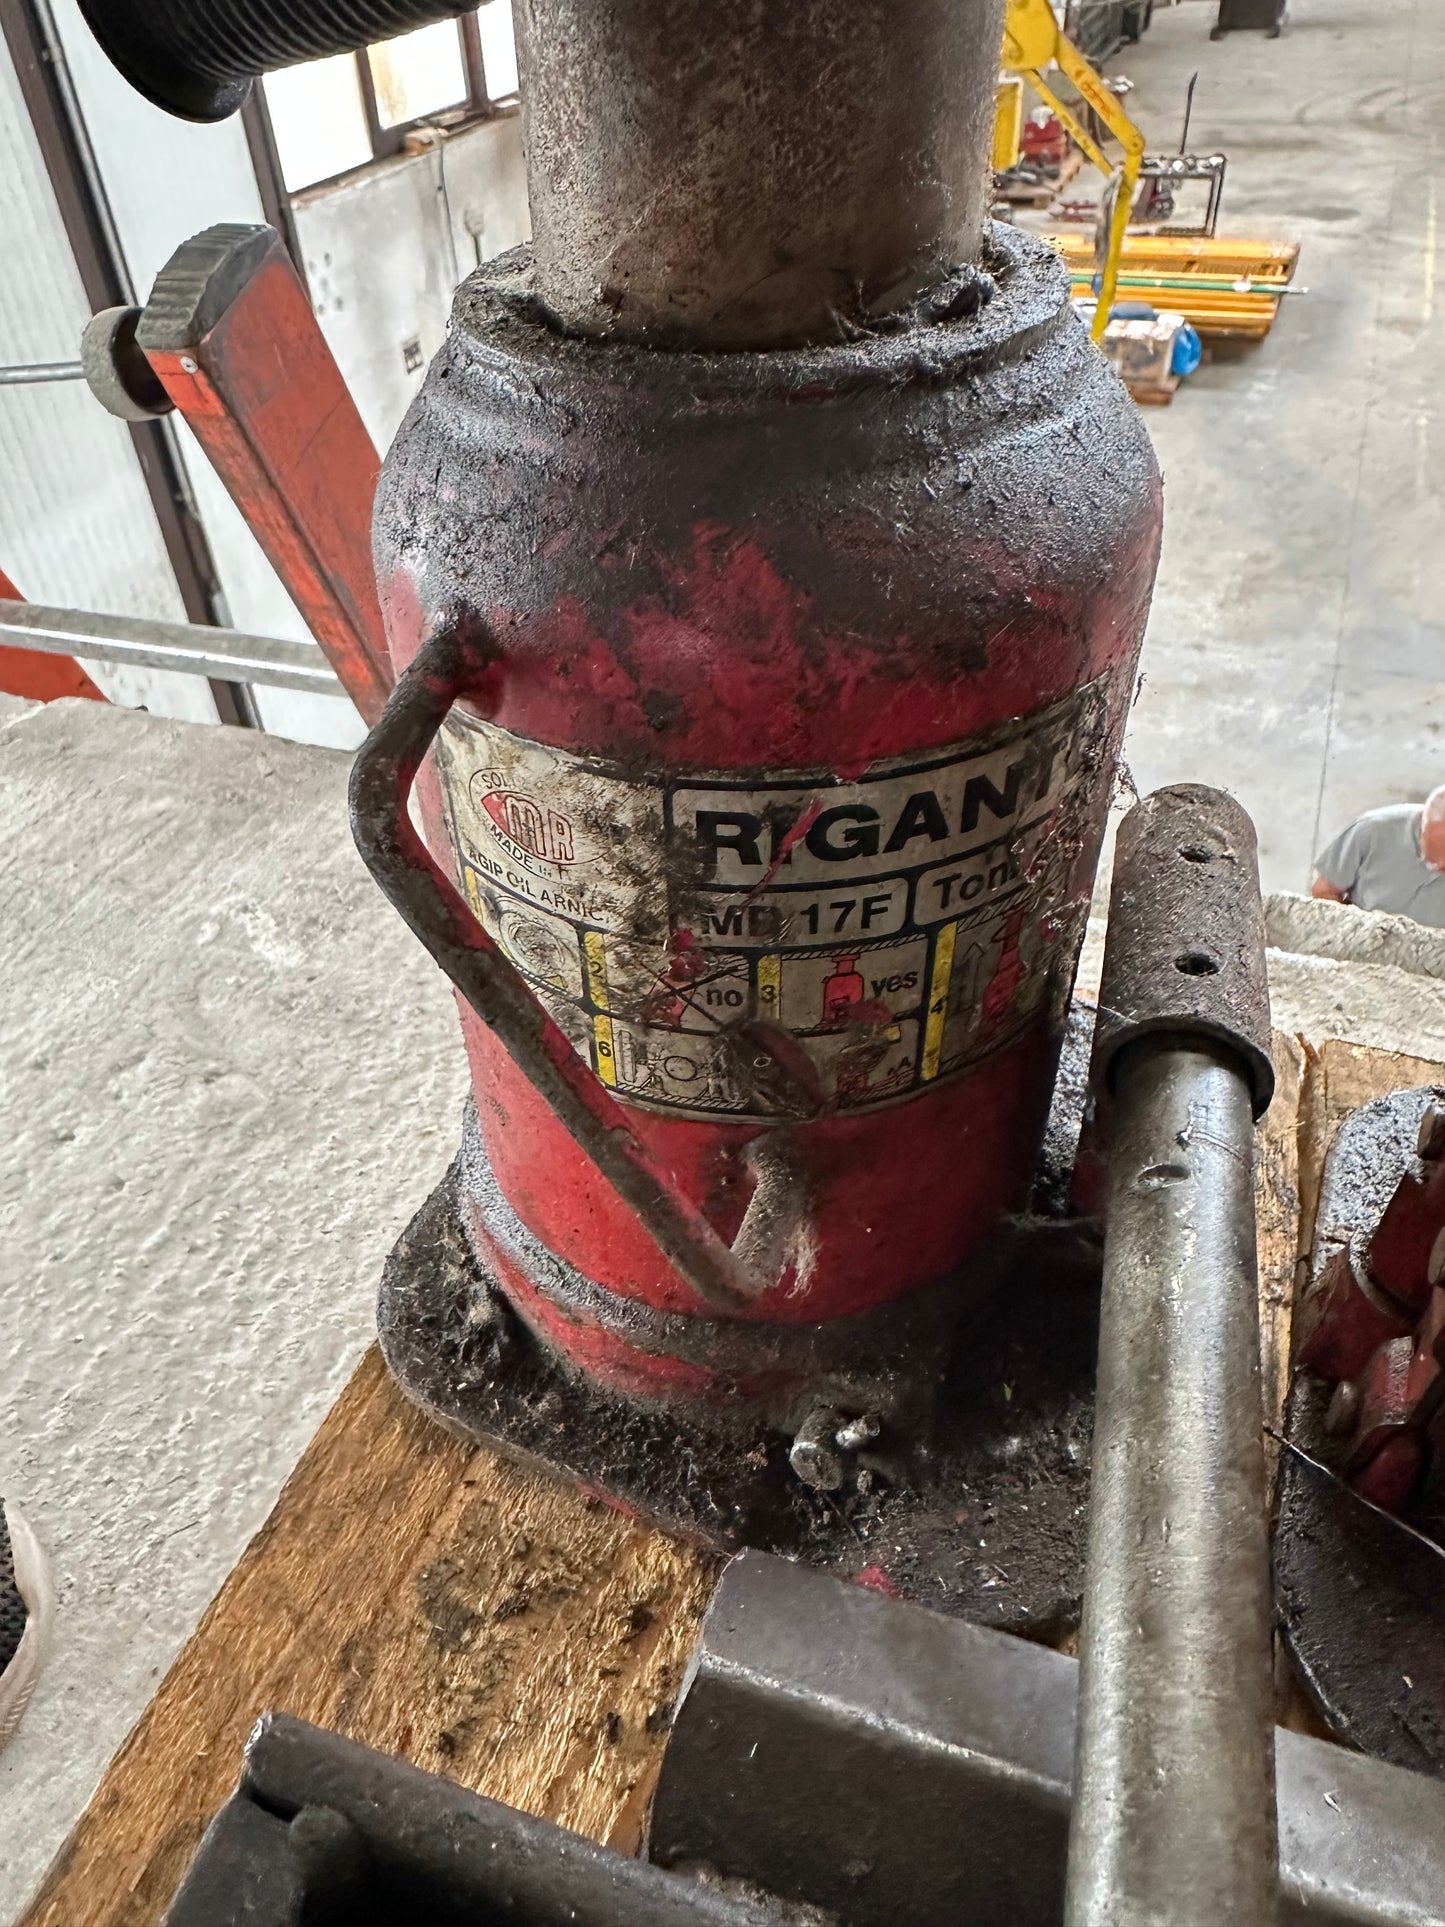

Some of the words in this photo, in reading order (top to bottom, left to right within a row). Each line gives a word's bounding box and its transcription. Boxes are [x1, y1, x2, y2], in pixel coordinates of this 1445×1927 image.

[490, 823, 534, 870] MADE
[468, 848, 503, 877] AGIP
[506, 871, 537, 899] OIL
[800, 892, 893, 936] 17F
[589, 960, 604, 979] 2
[870, 971, 919, 998] yes
[705, 987, 744, 1008] no
[930, 995, 949, 1015] 4
[598, 1040, 612, 1058] 6
